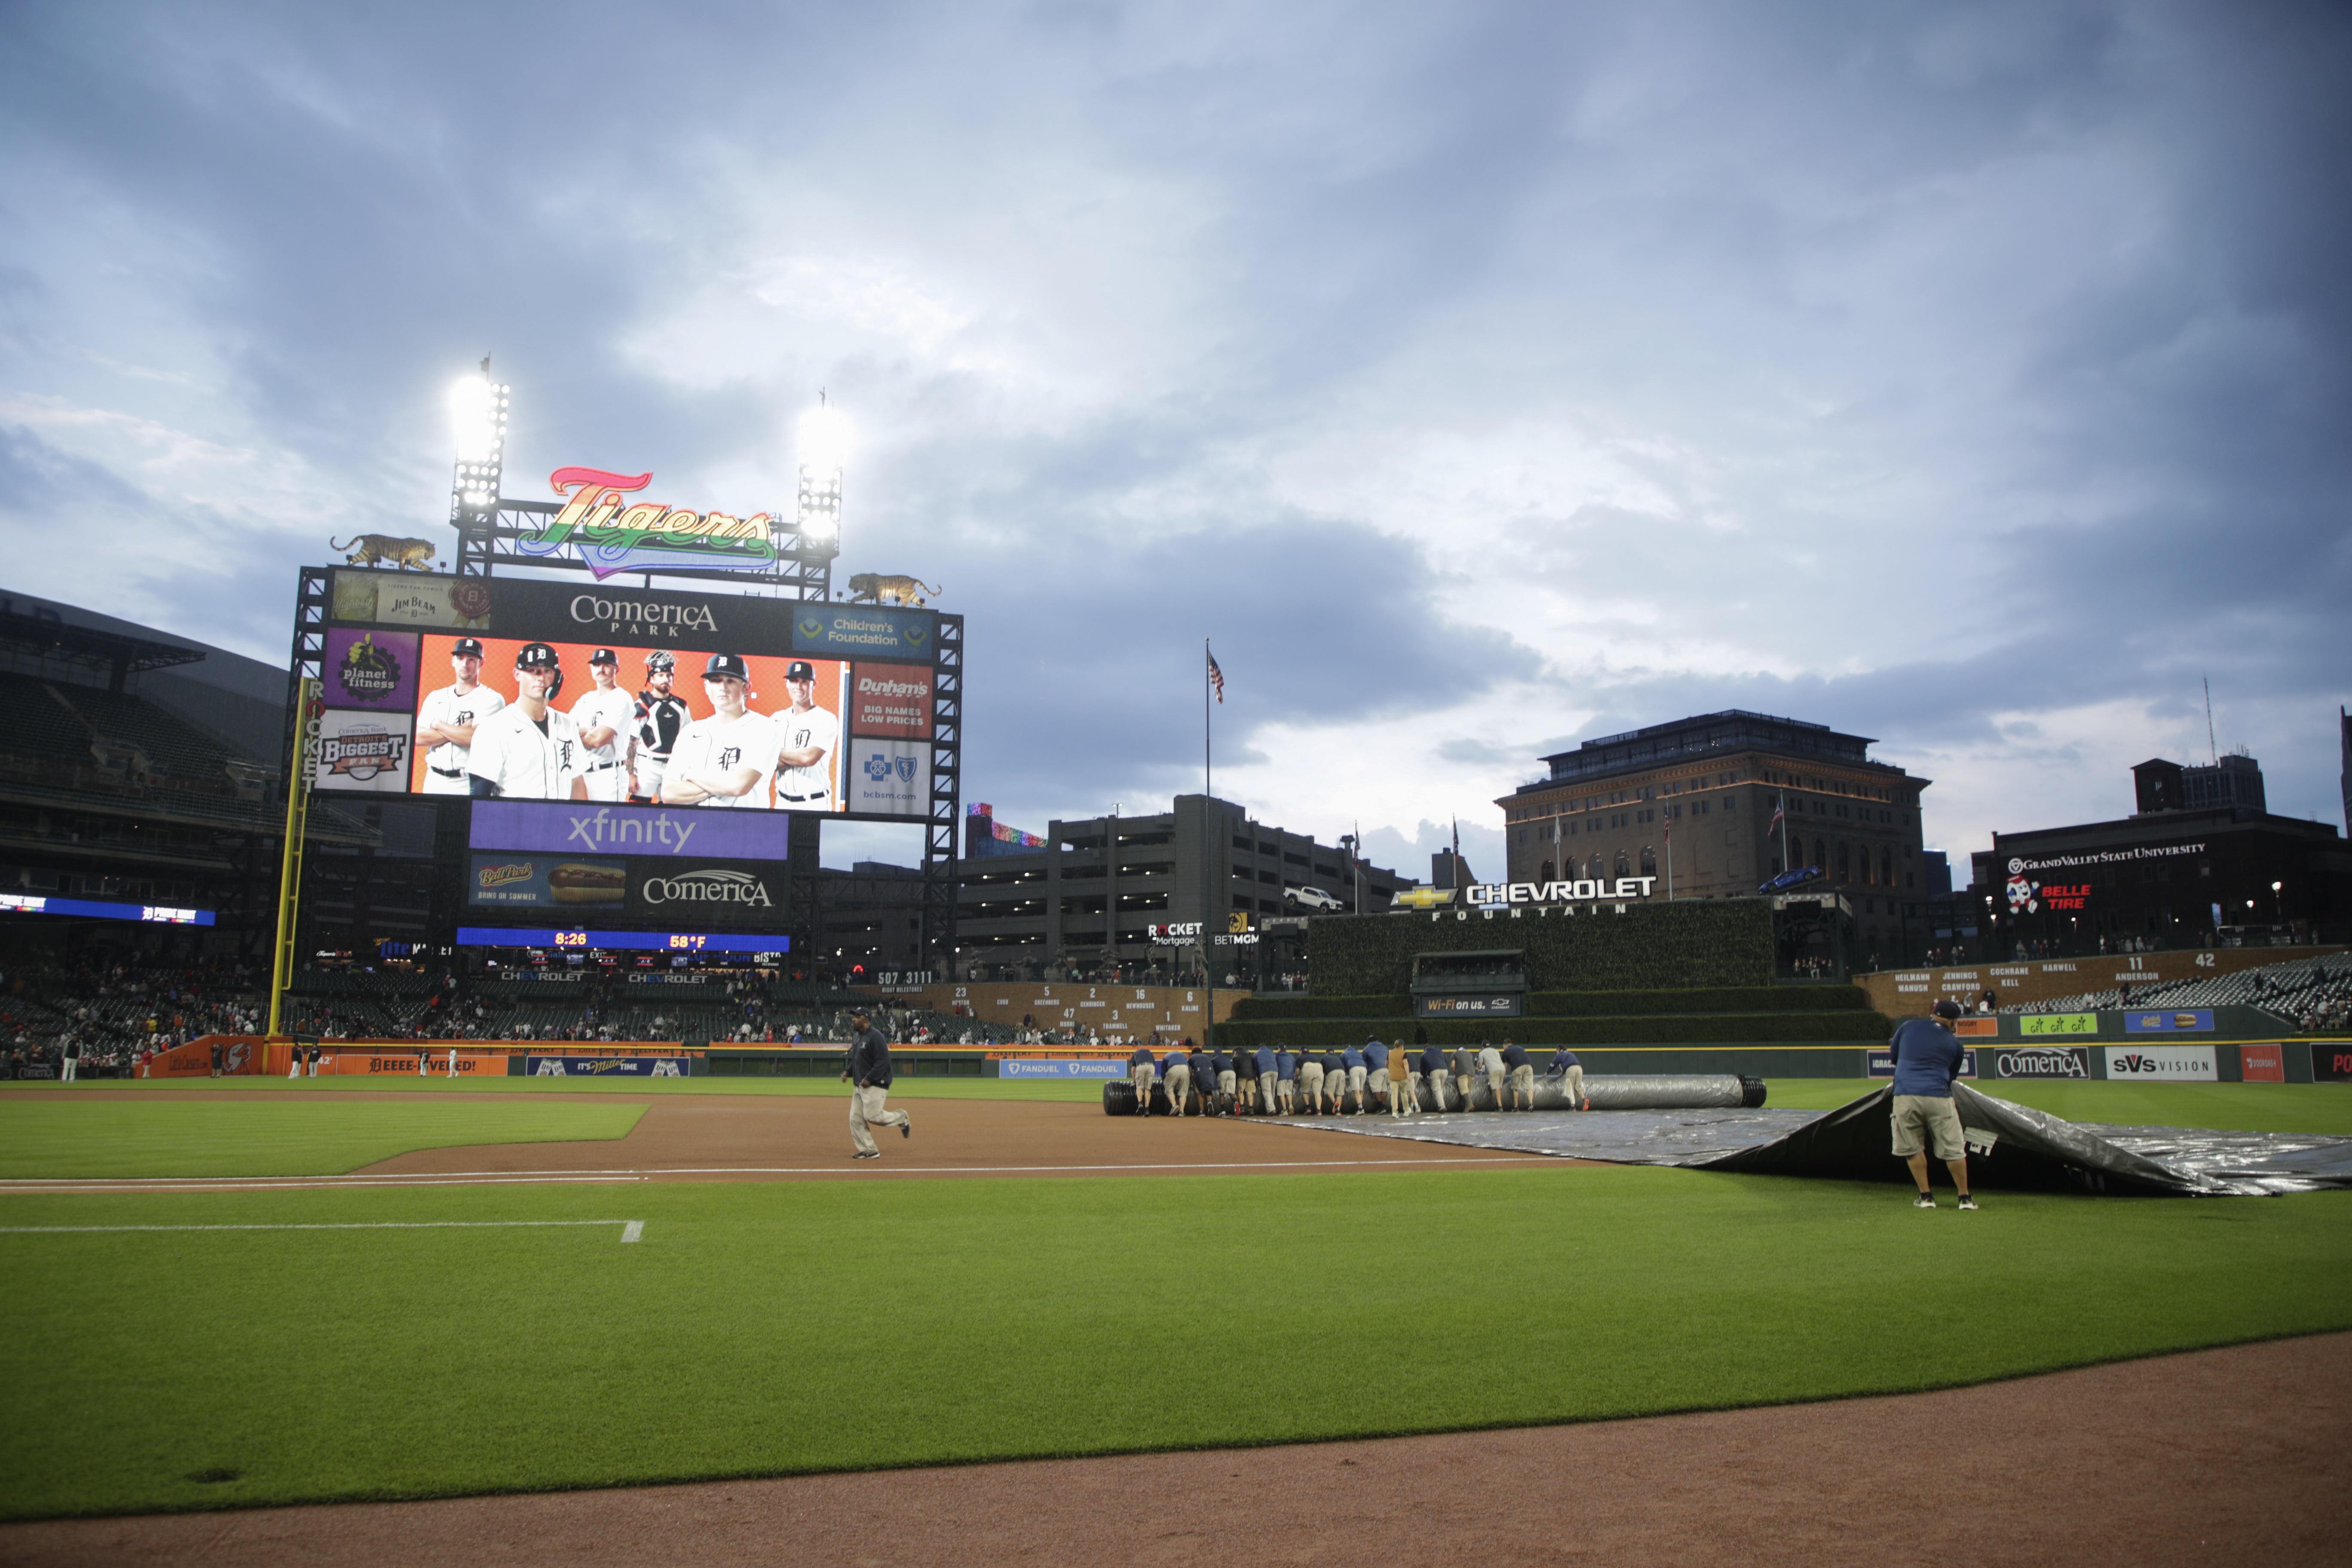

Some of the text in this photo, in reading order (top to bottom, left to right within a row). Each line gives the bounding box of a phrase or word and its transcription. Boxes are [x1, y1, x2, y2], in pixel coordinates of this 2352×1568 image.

[517, 466, 778, 578] Tigers
[392, 596, 435, 615] JIM BEAM
[611, 622, 678, 637] PARK
[834, 619, 894, 633] Children's
[828, 631, 897, 646] Foundation
[344, 668, 387, 680] planet
[349, 678, 395, 689] fitness
[858, 677, 928, 695] Dunham's
[864, 705, 922, 717] BIG NAMES
[861, 714, 924, 726] LOW PRICES
[341, 735, 387, 744] DETROIT'S
[323, 737, 404, 763] BIGGEST
[348, 757, 380, 766] FAN
[864, 790, 916, 800] bcbsm.com
[567, 808, 697, 853] xfinity
[2023, 843, 2206, 870] GRAND VALLEY STATE UNIVERSITY
[479, 863, 533, 886] Ball Park
[1466, 876, 1657, 904] CHEVROLET
[2042, 884, 2092, 897] BELLE
[509, 893, 536, 901] SUMMER
[2048, 898, 2085, 910] TIRE
[1432, 904, 1626, 922] FOUNTAIN
[1148, 922, 1203, 937] ROCKET
[555, 932, 587, 945] 8:26
[669, 934, 706, 948] 58°F
[1156, 937, 1195, 946] Mortgage
[1215, 934, 1259, 945] BETMGM
[380, 941, 410, 959] Lite
[2128, 957, 2143, 971] 11
[2195, 953, 2215, 967] 42
[1990, 967, 2029, 977] COCHRANE
[2043, 963, 2077, 972] HARWELL
[501, 971, 584, 981] CHEVROLET
[628, 974, 708, 984] CHEVROLET
[878, 972, 898, 984] 507
[906, 971, 932, 983] 3111
[1895, 973, 1930, 982] HEILMANN
[1943, 971, 1977, 980] JENNINGS
[2115, 972, 2159, 981] ANDERSON
[1898, 983, 1929, 992] MANUSH
[1942, 983, 1980, 992] CRAWFORD
[2001, 978, 2019, 987] KELL
[956, 987, 966, 997] 23
[1044, 986, 1050, 996] 5
[1090, 988, 1096, 998] 2
[1136, 989, 1145, 1000] 16
[1187, 991, 1193, 1002] 6
[1428, 998, 1485, 1010] Wi-Fi on us.
[1063, 1008, 1075, 1018] 47
[1112, 1010, 1118, 1020] 3
[1166, 1011, 1170, 1022] 1
[2030, 1020, 2043, 1033] GFL
[2051, 1020, 2064, 1032] GFL
[2072, 1018, 2086, 1032] GFL
[589, 1058, 627, 1075] Miller
[2159, 1060, 2209, 1072] VISION
